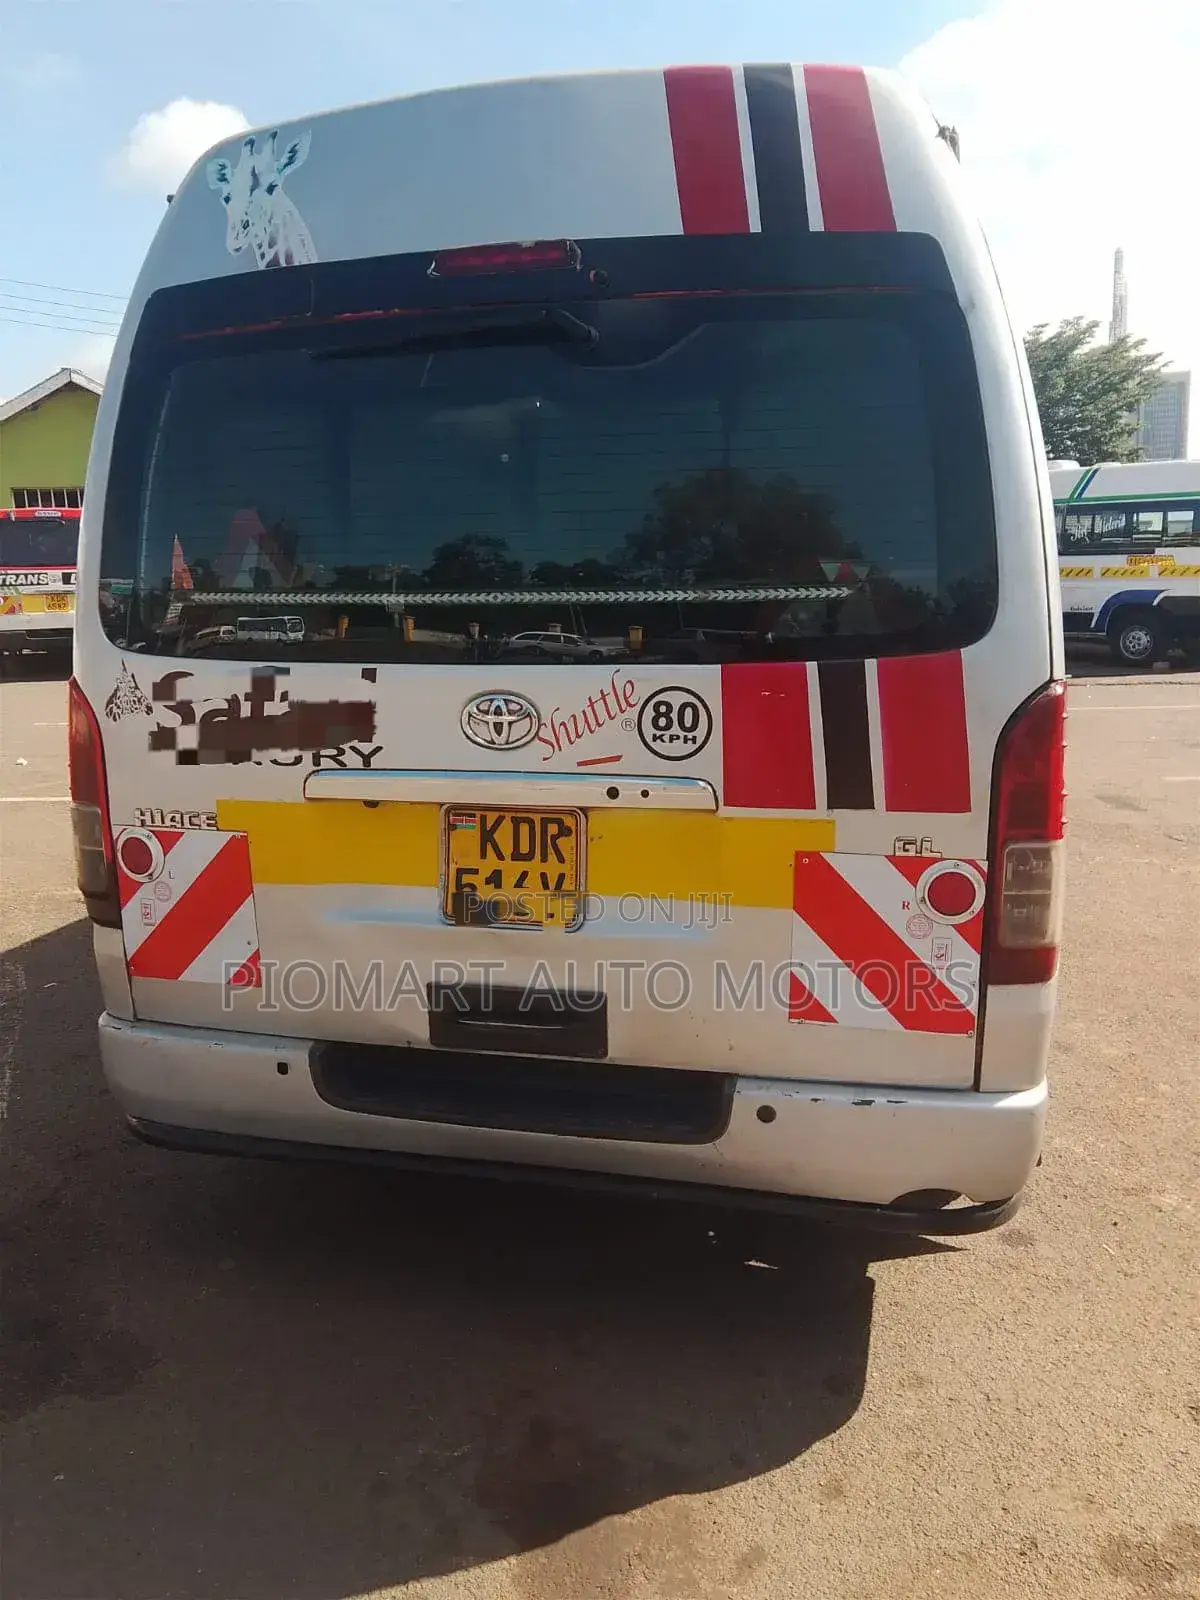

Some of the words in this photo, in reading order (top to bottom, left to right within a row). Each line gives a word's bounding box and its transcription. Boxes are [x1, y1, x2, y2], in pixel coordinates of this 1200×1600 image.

[0, 574, 48, 585] TRANS
[535, 668, 641, 761] Shuttle
[650, 700, 700, 733] 80
[651, 733, 698, 745] KPH
[133, 808, 218, 831] HIACE
[479, 814, 567, 864] KDR
